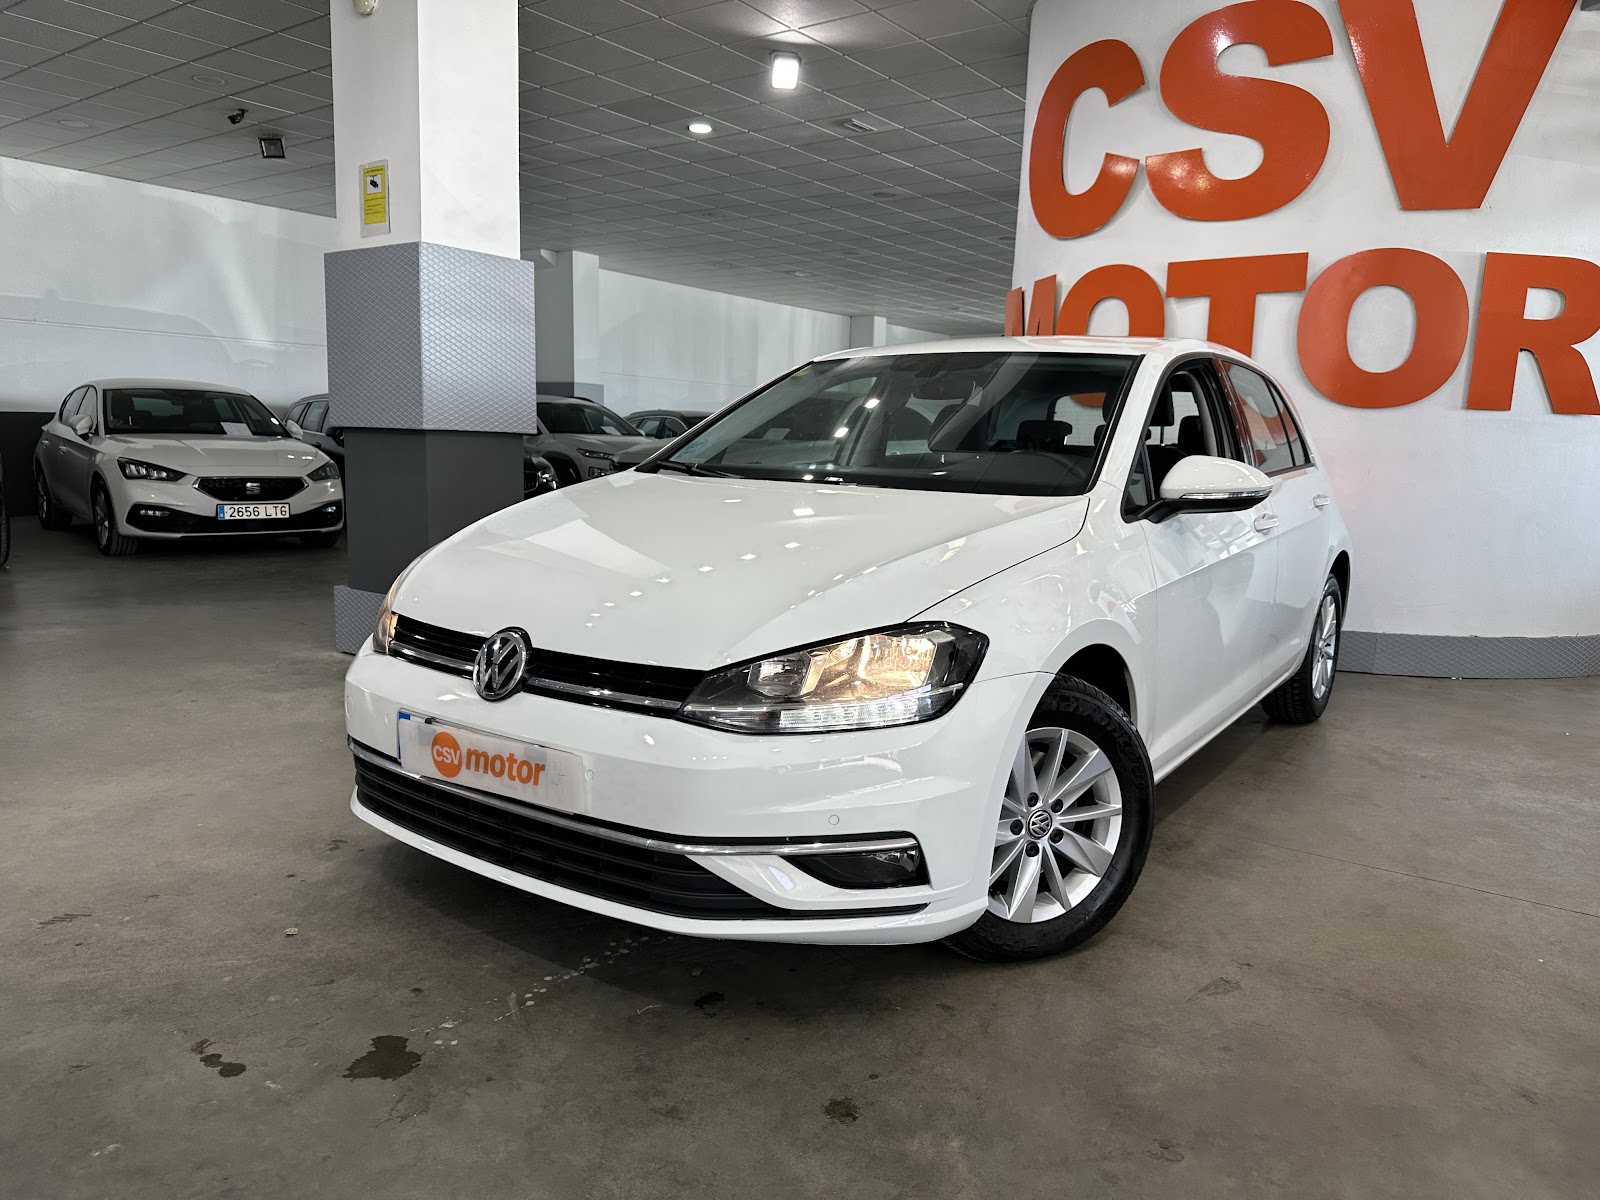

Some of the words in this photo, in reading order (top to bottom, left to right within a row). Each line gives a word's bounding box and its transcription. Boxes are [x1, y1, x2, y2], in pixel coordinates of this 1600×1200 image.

[1029, 0, 1578, 239] CSV
[229, 506, 260, 518] 2656
[465, 747, 546, 787] motor
